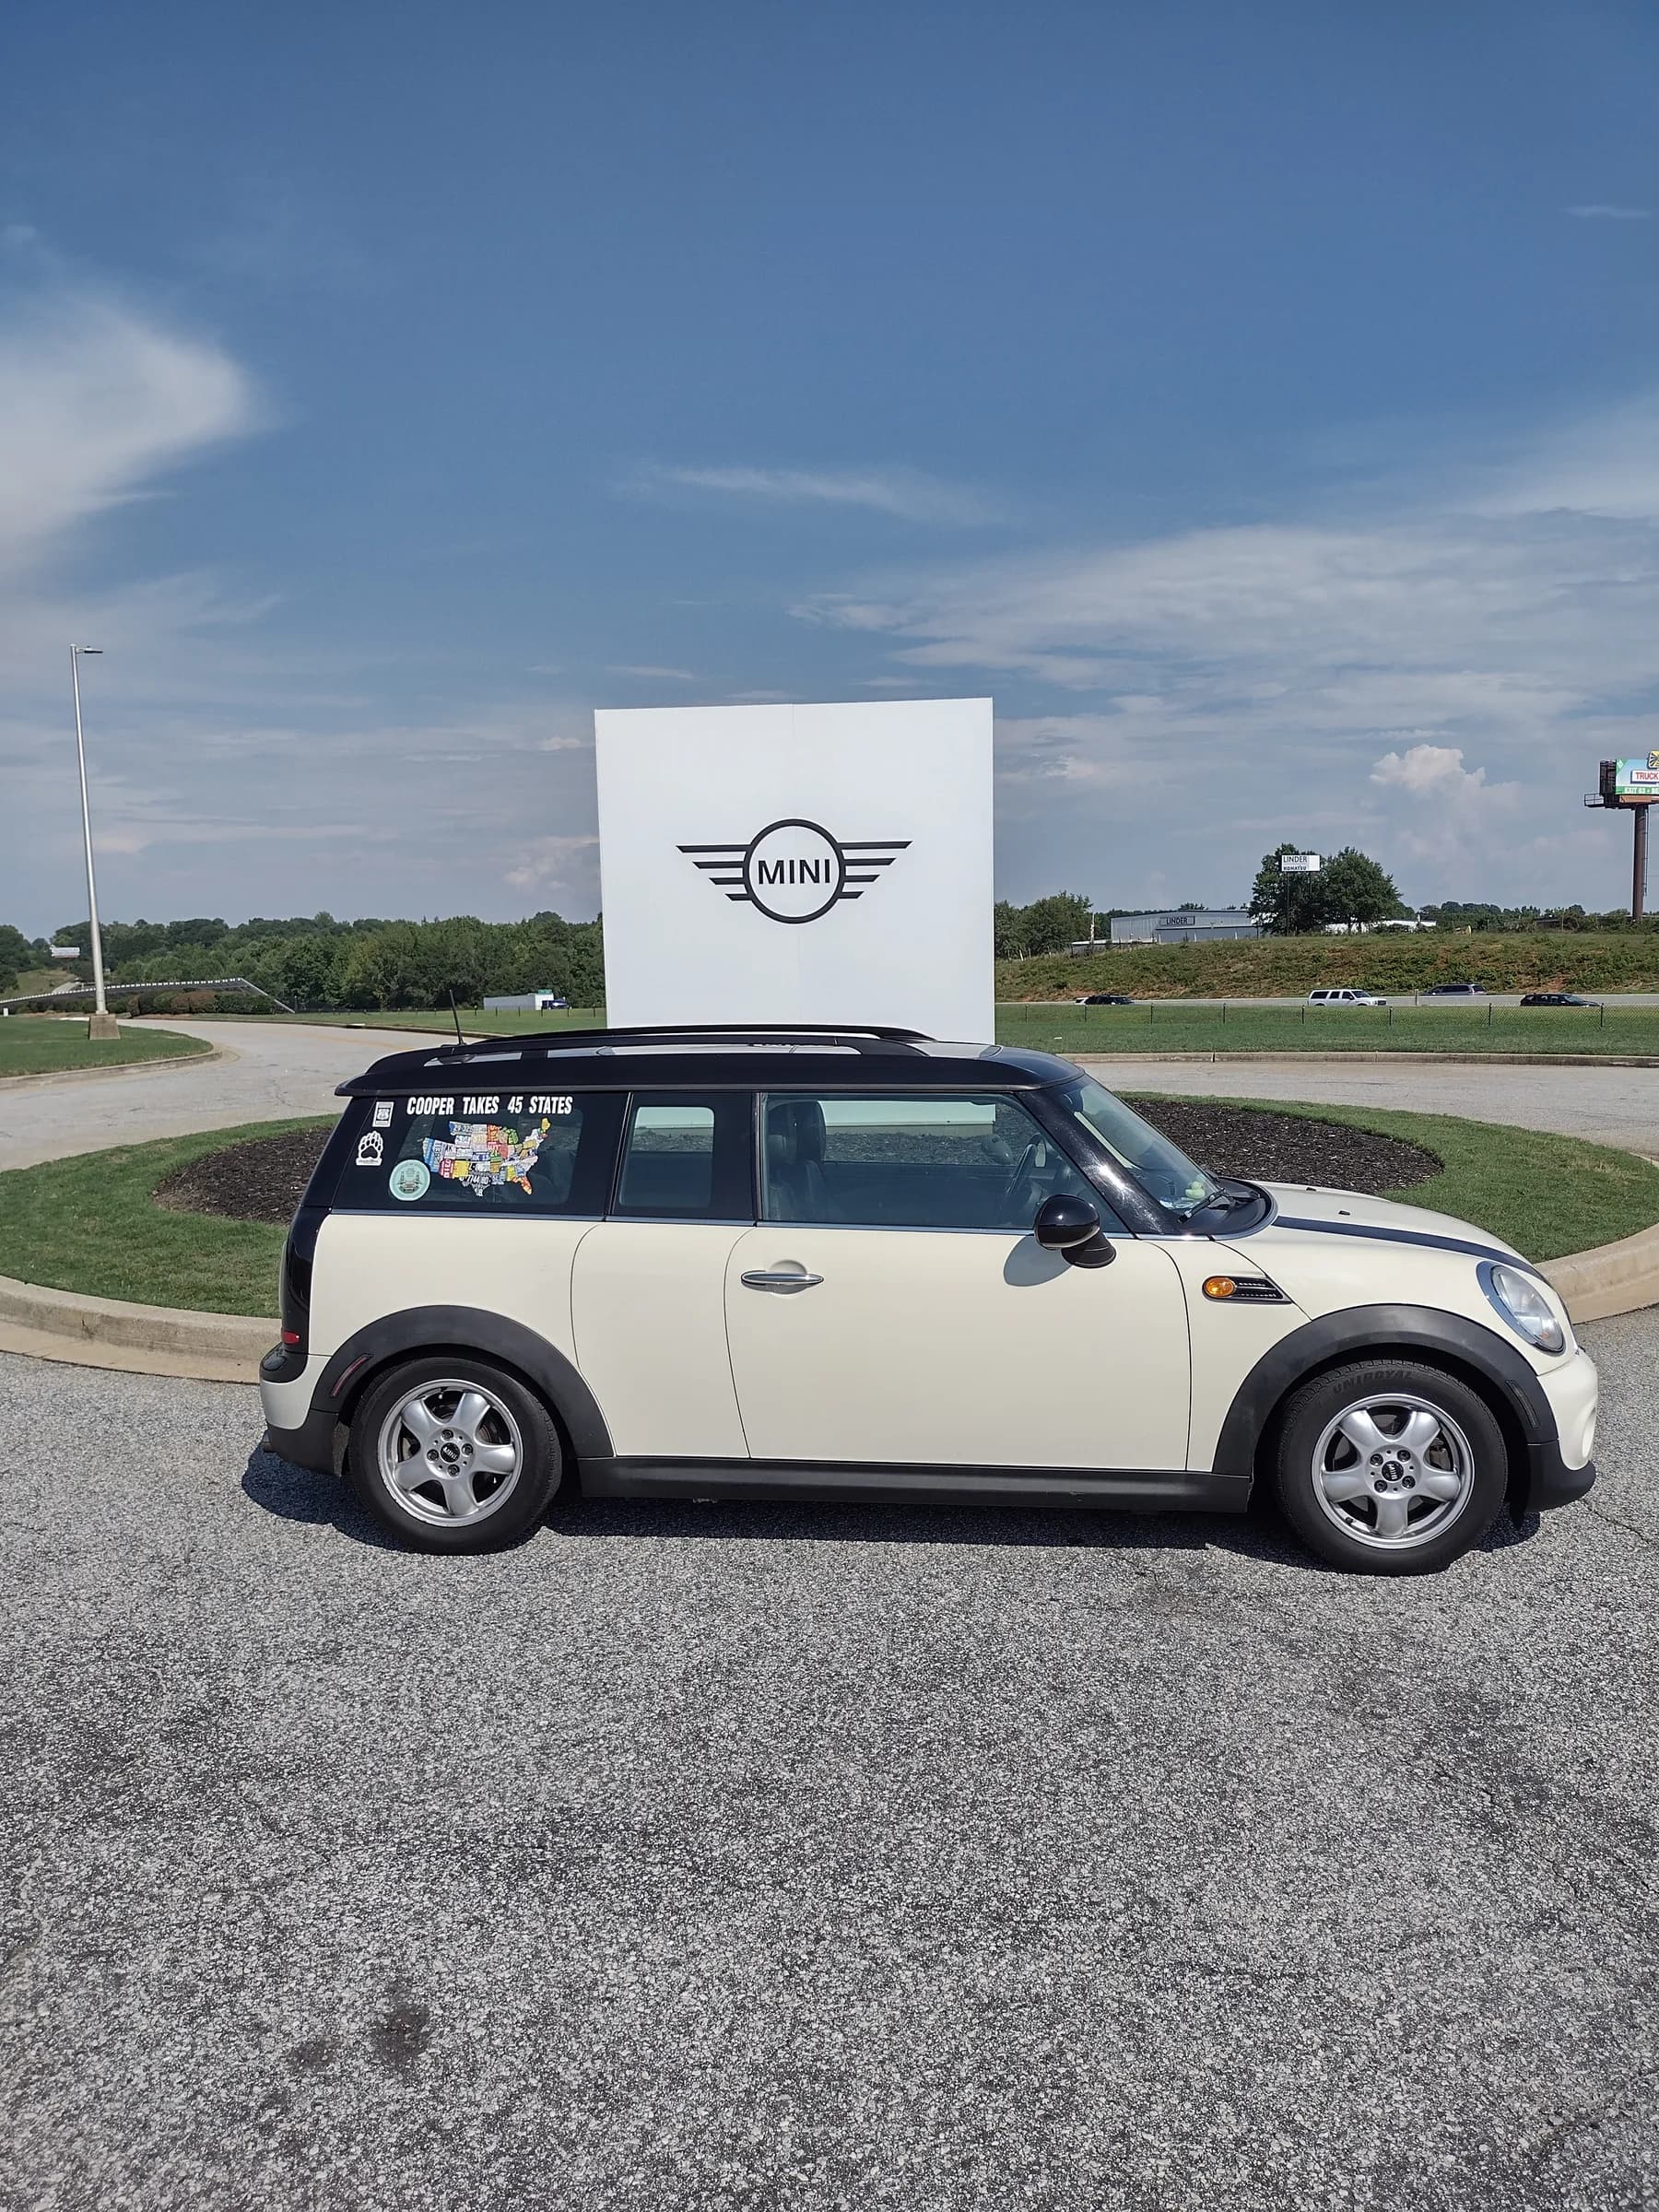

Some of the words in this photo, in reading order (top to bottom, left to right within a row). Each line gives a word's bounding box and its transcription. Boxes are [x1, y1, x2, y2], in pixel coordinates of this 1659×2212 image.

[1635, 771, 1659, 780] TRUCK
[758, 859, 830, 884] MINI
[406, 1097, 454, 1115] COOPER
[463, 1096, 500, 1114] TAKES
[508, 1096, 524, 1113] 45
[528, 1096, 573, 1114] STATES
[1333, 1371, 1413, 1394] UNIROYAL
